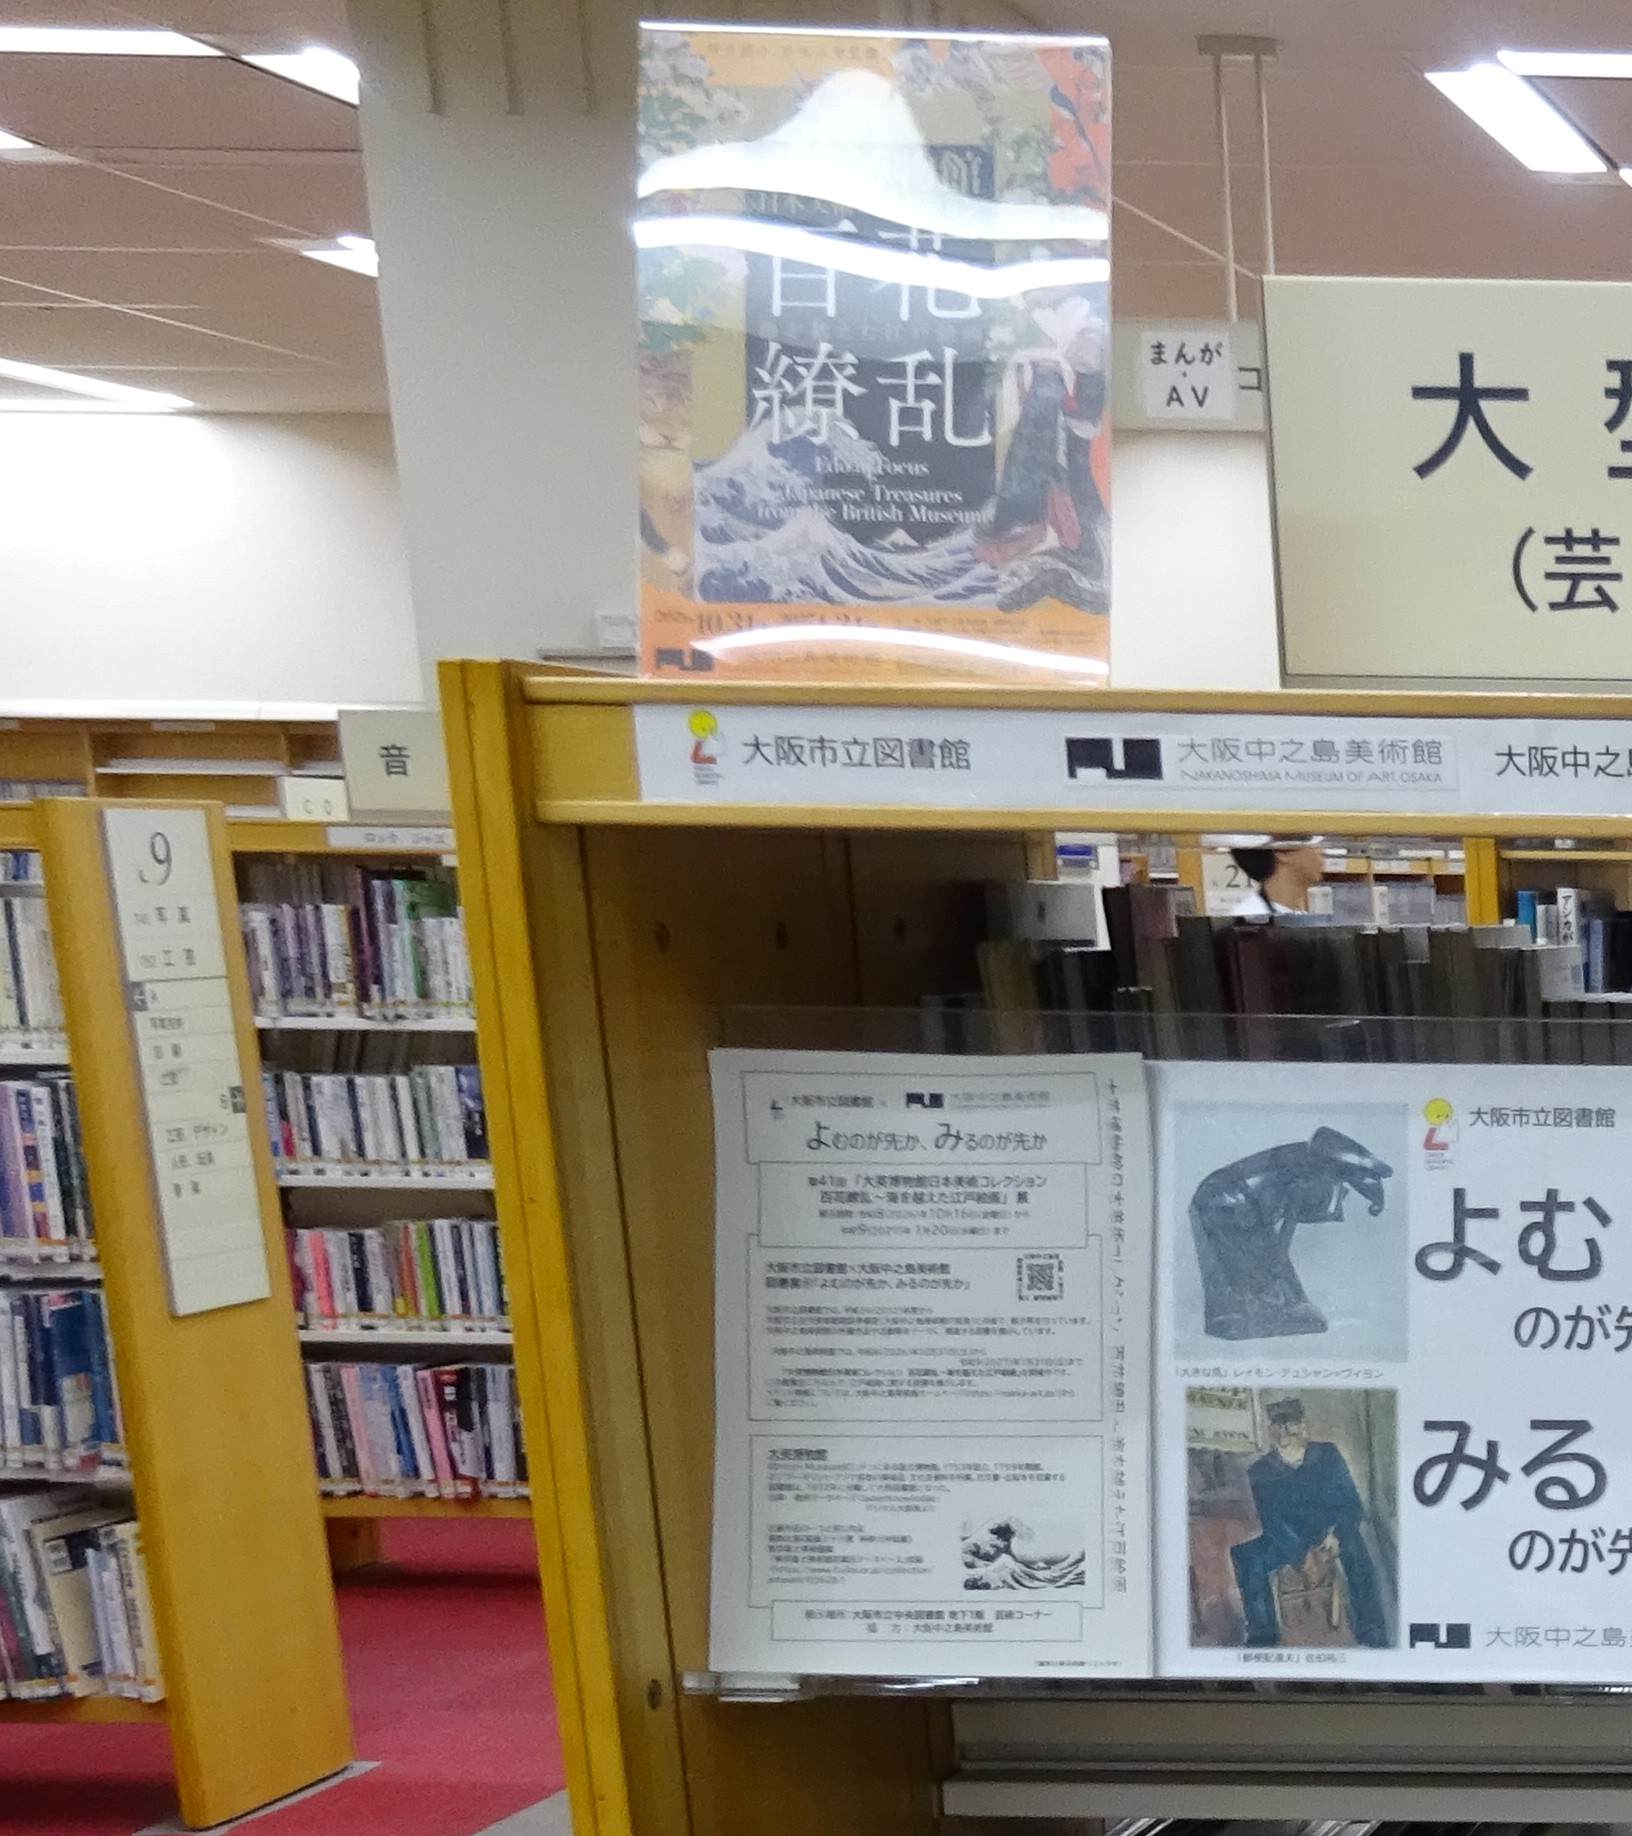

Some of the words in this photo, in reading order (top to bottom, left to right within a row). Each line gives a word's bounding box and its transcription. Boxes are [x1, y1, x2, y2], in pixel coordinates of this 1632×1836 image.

[1149, 341, 1224, 367] まんが
[752, 341, 994, 449] 繚乱
[874, 487, 964, 505] Treasures
[841, 505, 904, 524] British
[910, 506, 993, 525] Museum
[379, 742, 411, 778] 音
[742, 735, 972, 772] 大阪市立図書館
[1177, 737, 1443, 767] 大阪中之島美術館
[1181, 768, 1282, 783] NAKANOSHIMA
[1285, 769, 1346, 783] MUSEUM
[1401, 772, 1443, 784] OSAKA
[139, 831, 173, 886] 9
[1468, 1106, 1616, 1129] 大阪市立図書館
[1412, 1187, 1614, 1282] よむ
[1412, 1418, 1609, 1513] みる
